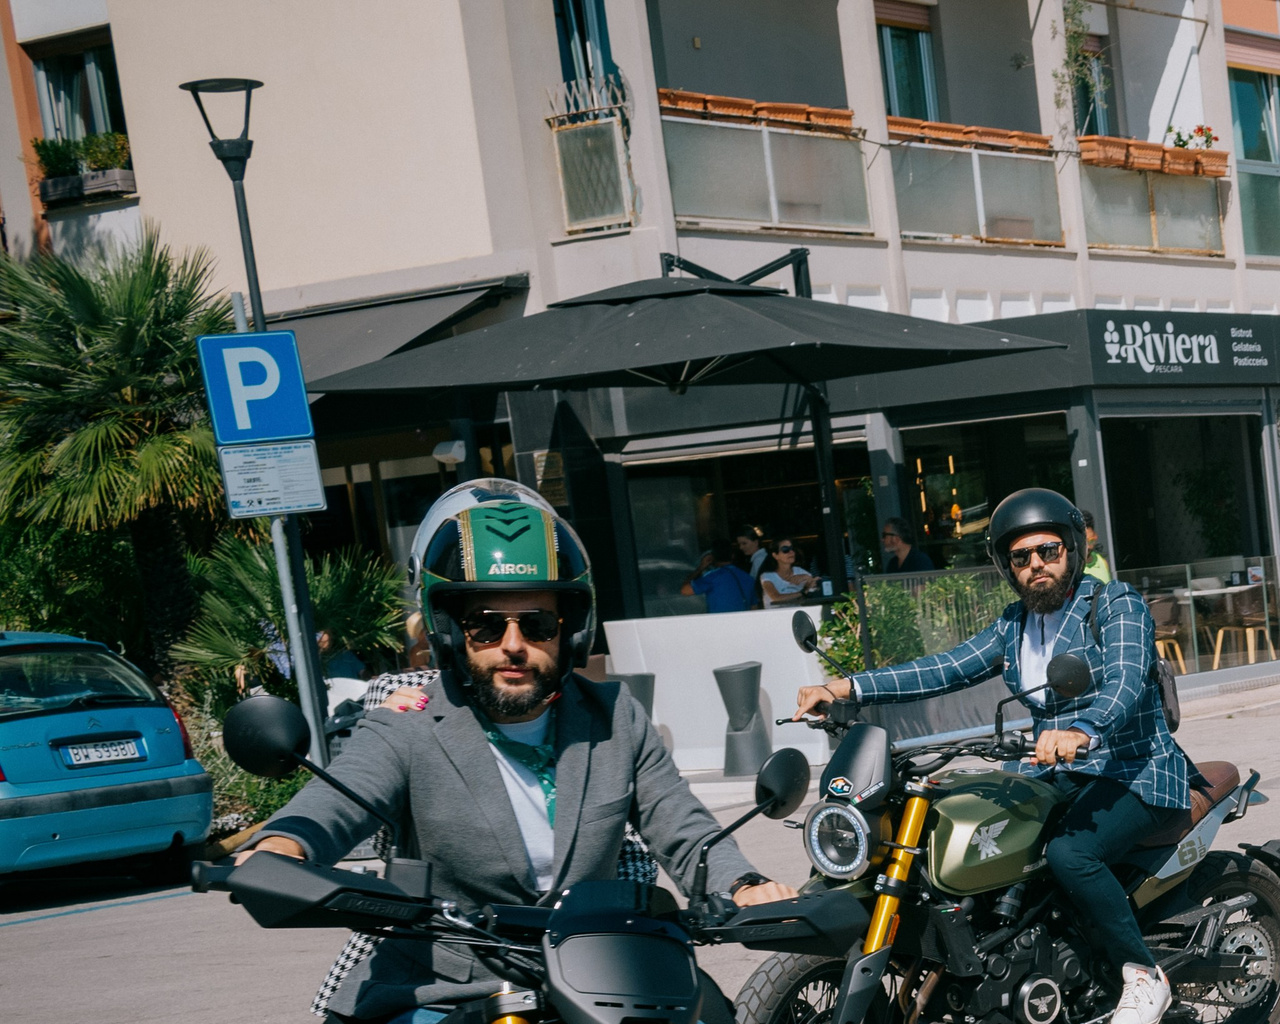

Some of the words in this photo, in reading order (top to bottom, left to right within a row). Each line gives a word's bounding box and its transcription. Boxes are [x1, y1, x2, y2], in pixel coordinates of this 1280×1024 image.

[1230, 327, 1253, 338] Bistrot
[1120, 321, 1220, 373] Riviera
[1232, 342, 1262, 352] Gelateria
[1233, 356, 1268, 366] Pasticceria
[1155, 365, 1183, 373] PESCARA
[222, 346, 280, 430] P
[488, 564, 537, 575] AIROH
[94, 740, 136, 759] 599BD
